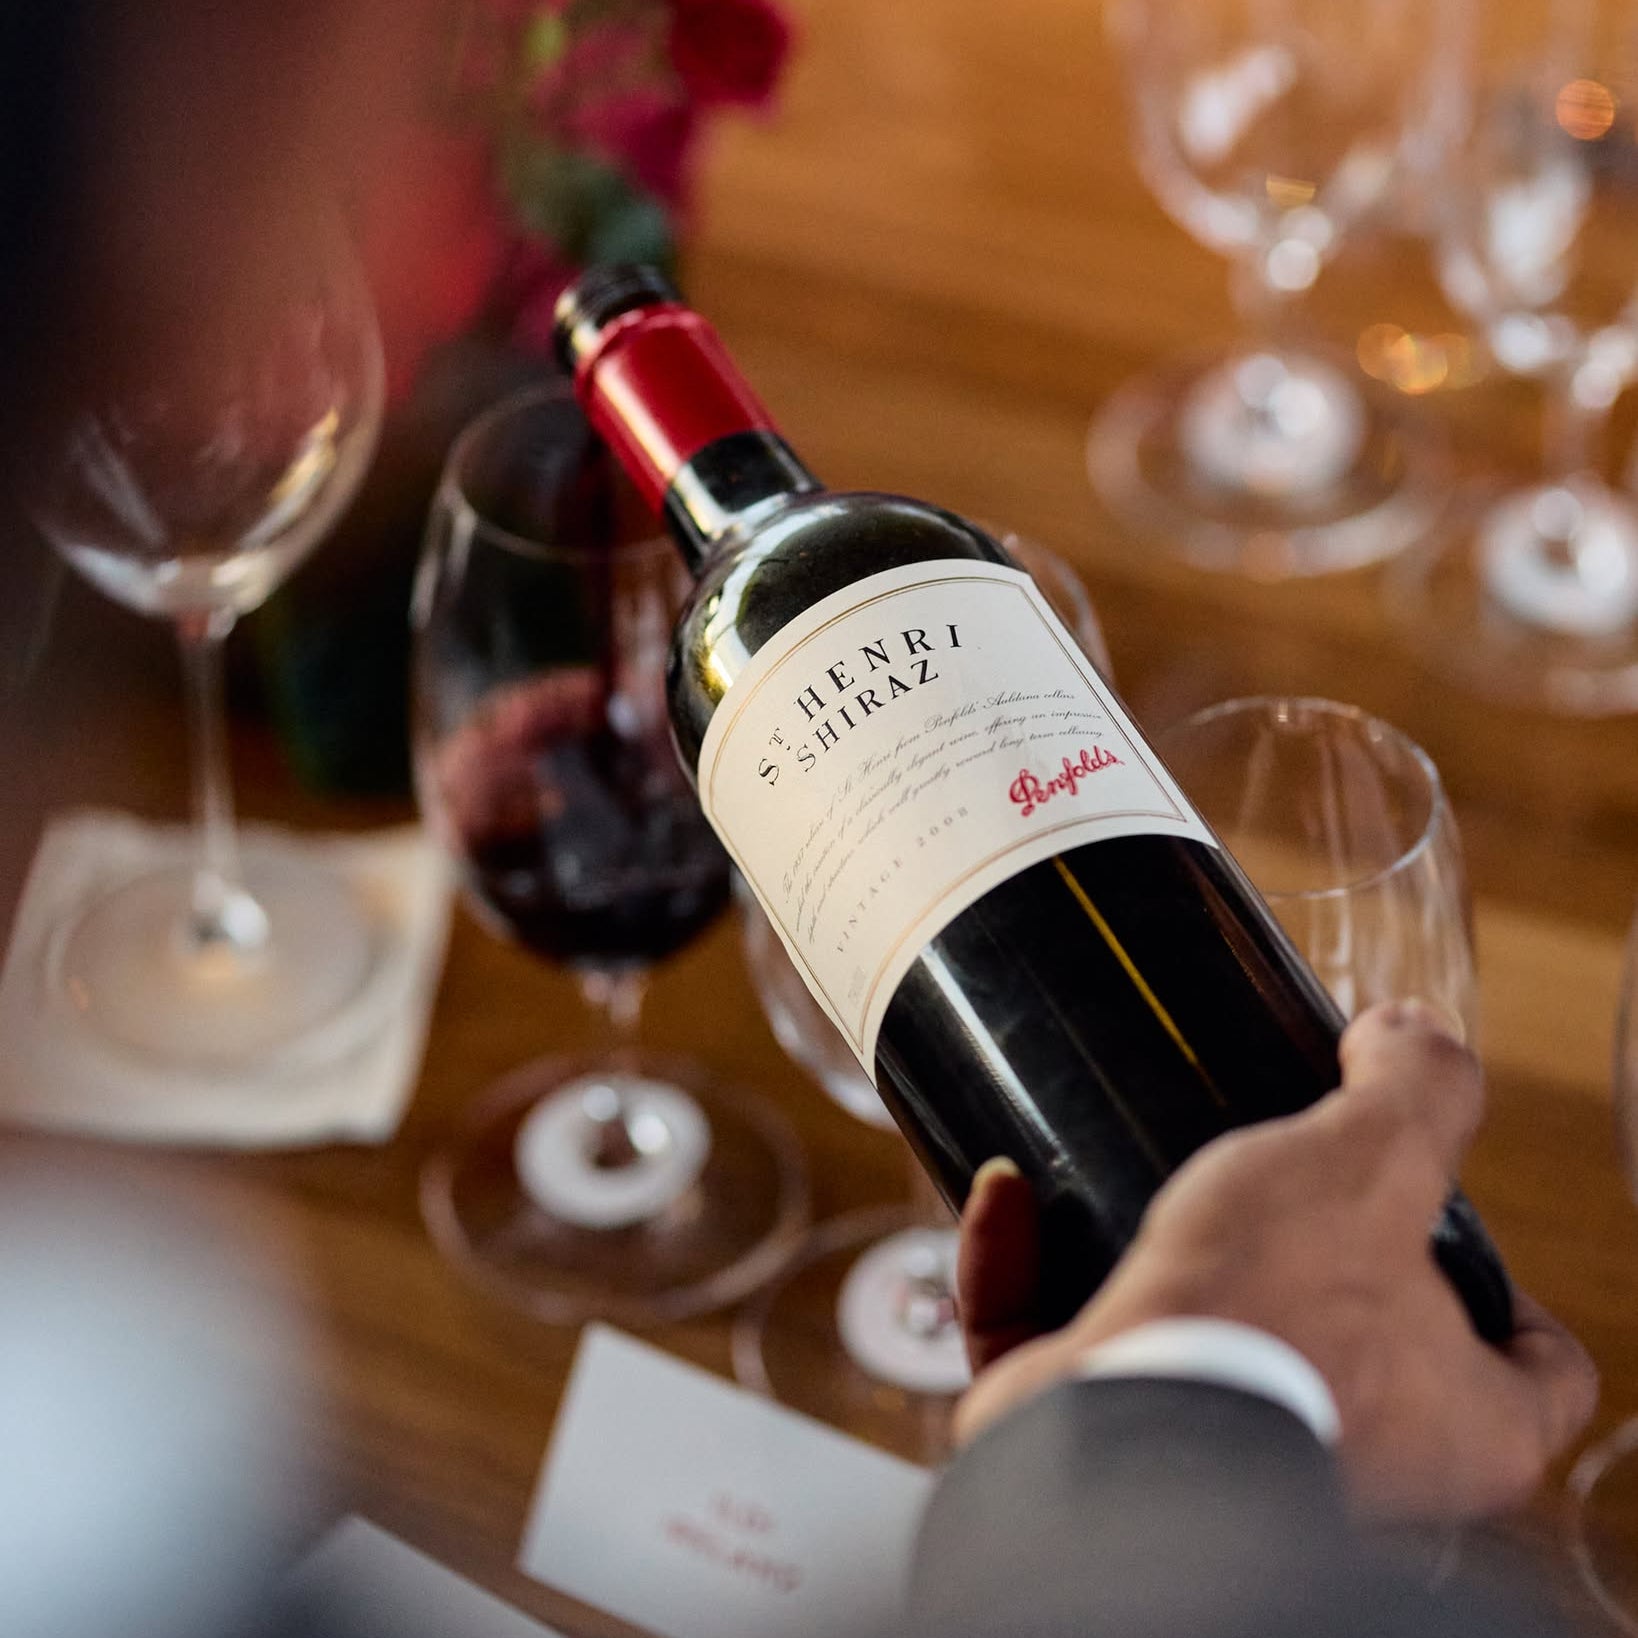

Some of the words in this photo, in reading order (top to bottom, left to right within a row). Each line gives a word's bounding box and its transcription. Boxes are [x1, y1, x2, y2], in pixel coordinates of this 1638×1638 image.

[793, 624, 962, 722] HENRI
[797, 659, 939, 772] SHIRAZ
[894, 732, 920, 759] from
[1009, 745, 1125, 817] Penfolds
[837, 859, 901, 953] VINTAGE
[916, 806, 968, 848] 2008
